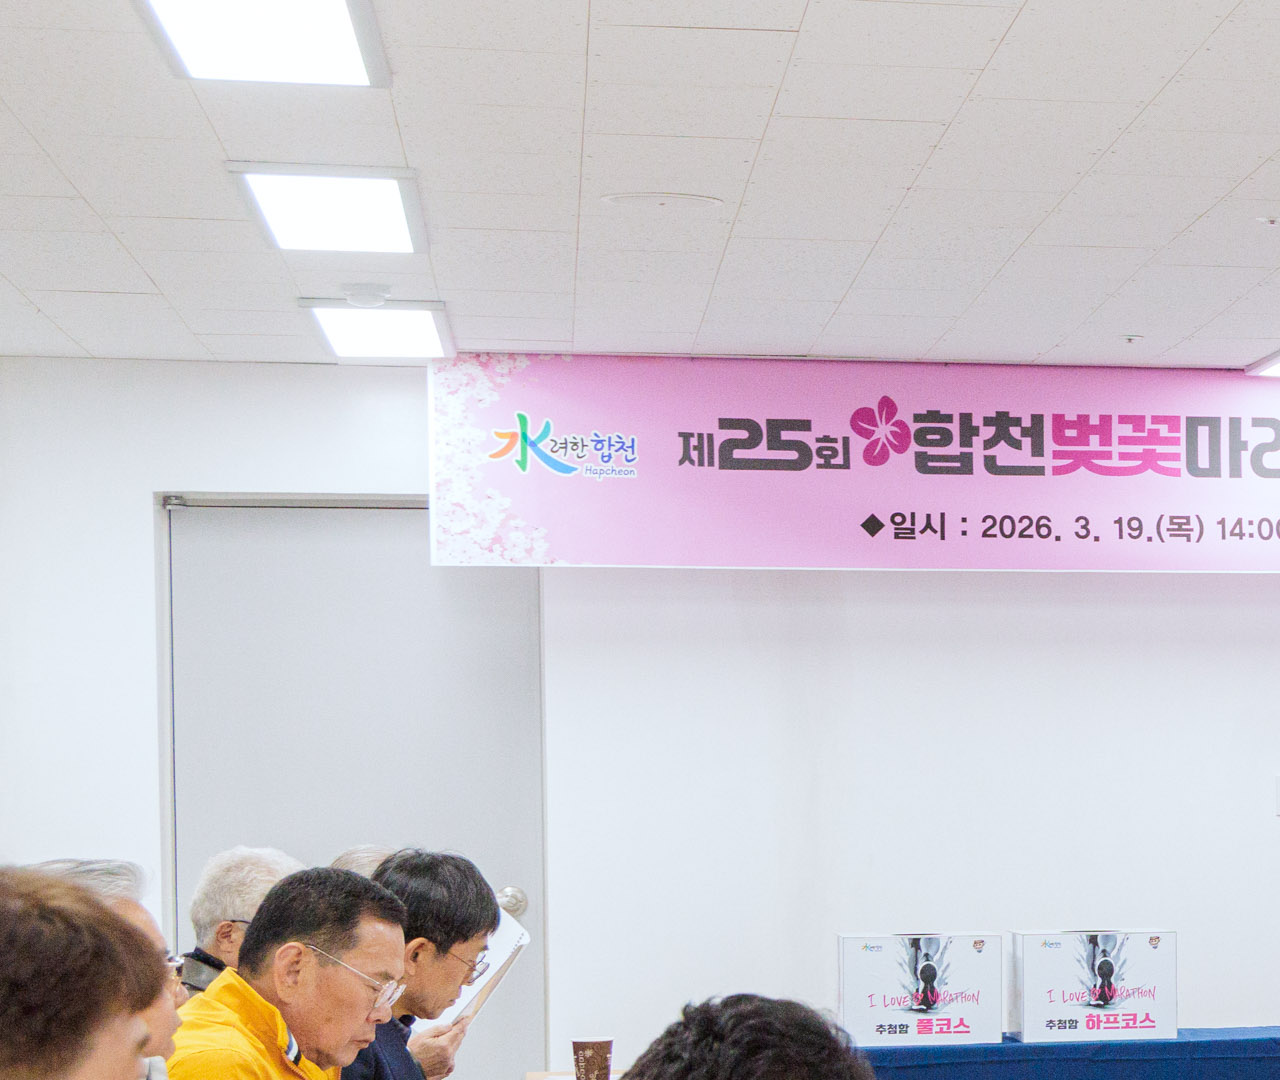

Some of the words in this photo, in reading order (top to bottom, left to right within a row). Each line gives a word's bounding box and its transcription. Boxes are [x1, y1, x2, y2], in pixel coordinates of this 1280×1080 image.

[590, 431, 637, 464] 합천
[678, 417, 851, 471] 제25회
[585, 465, 636, 478] Hapcheon
[981, 516, 1062, 543] 2026.
[1074, 516, 1100, 543] 3.
[883, 993, 911, 1008] LOVE
[1062, 988, 1089, 1003] LOVE
[875, 1023, 909, 1035] 추첨함
[916, 1017, 971, 1035] 풀코스
[1045, 1019, 1079, 1030] 추첨함
[1085, 1013, 1156, 1030] 하프코스
